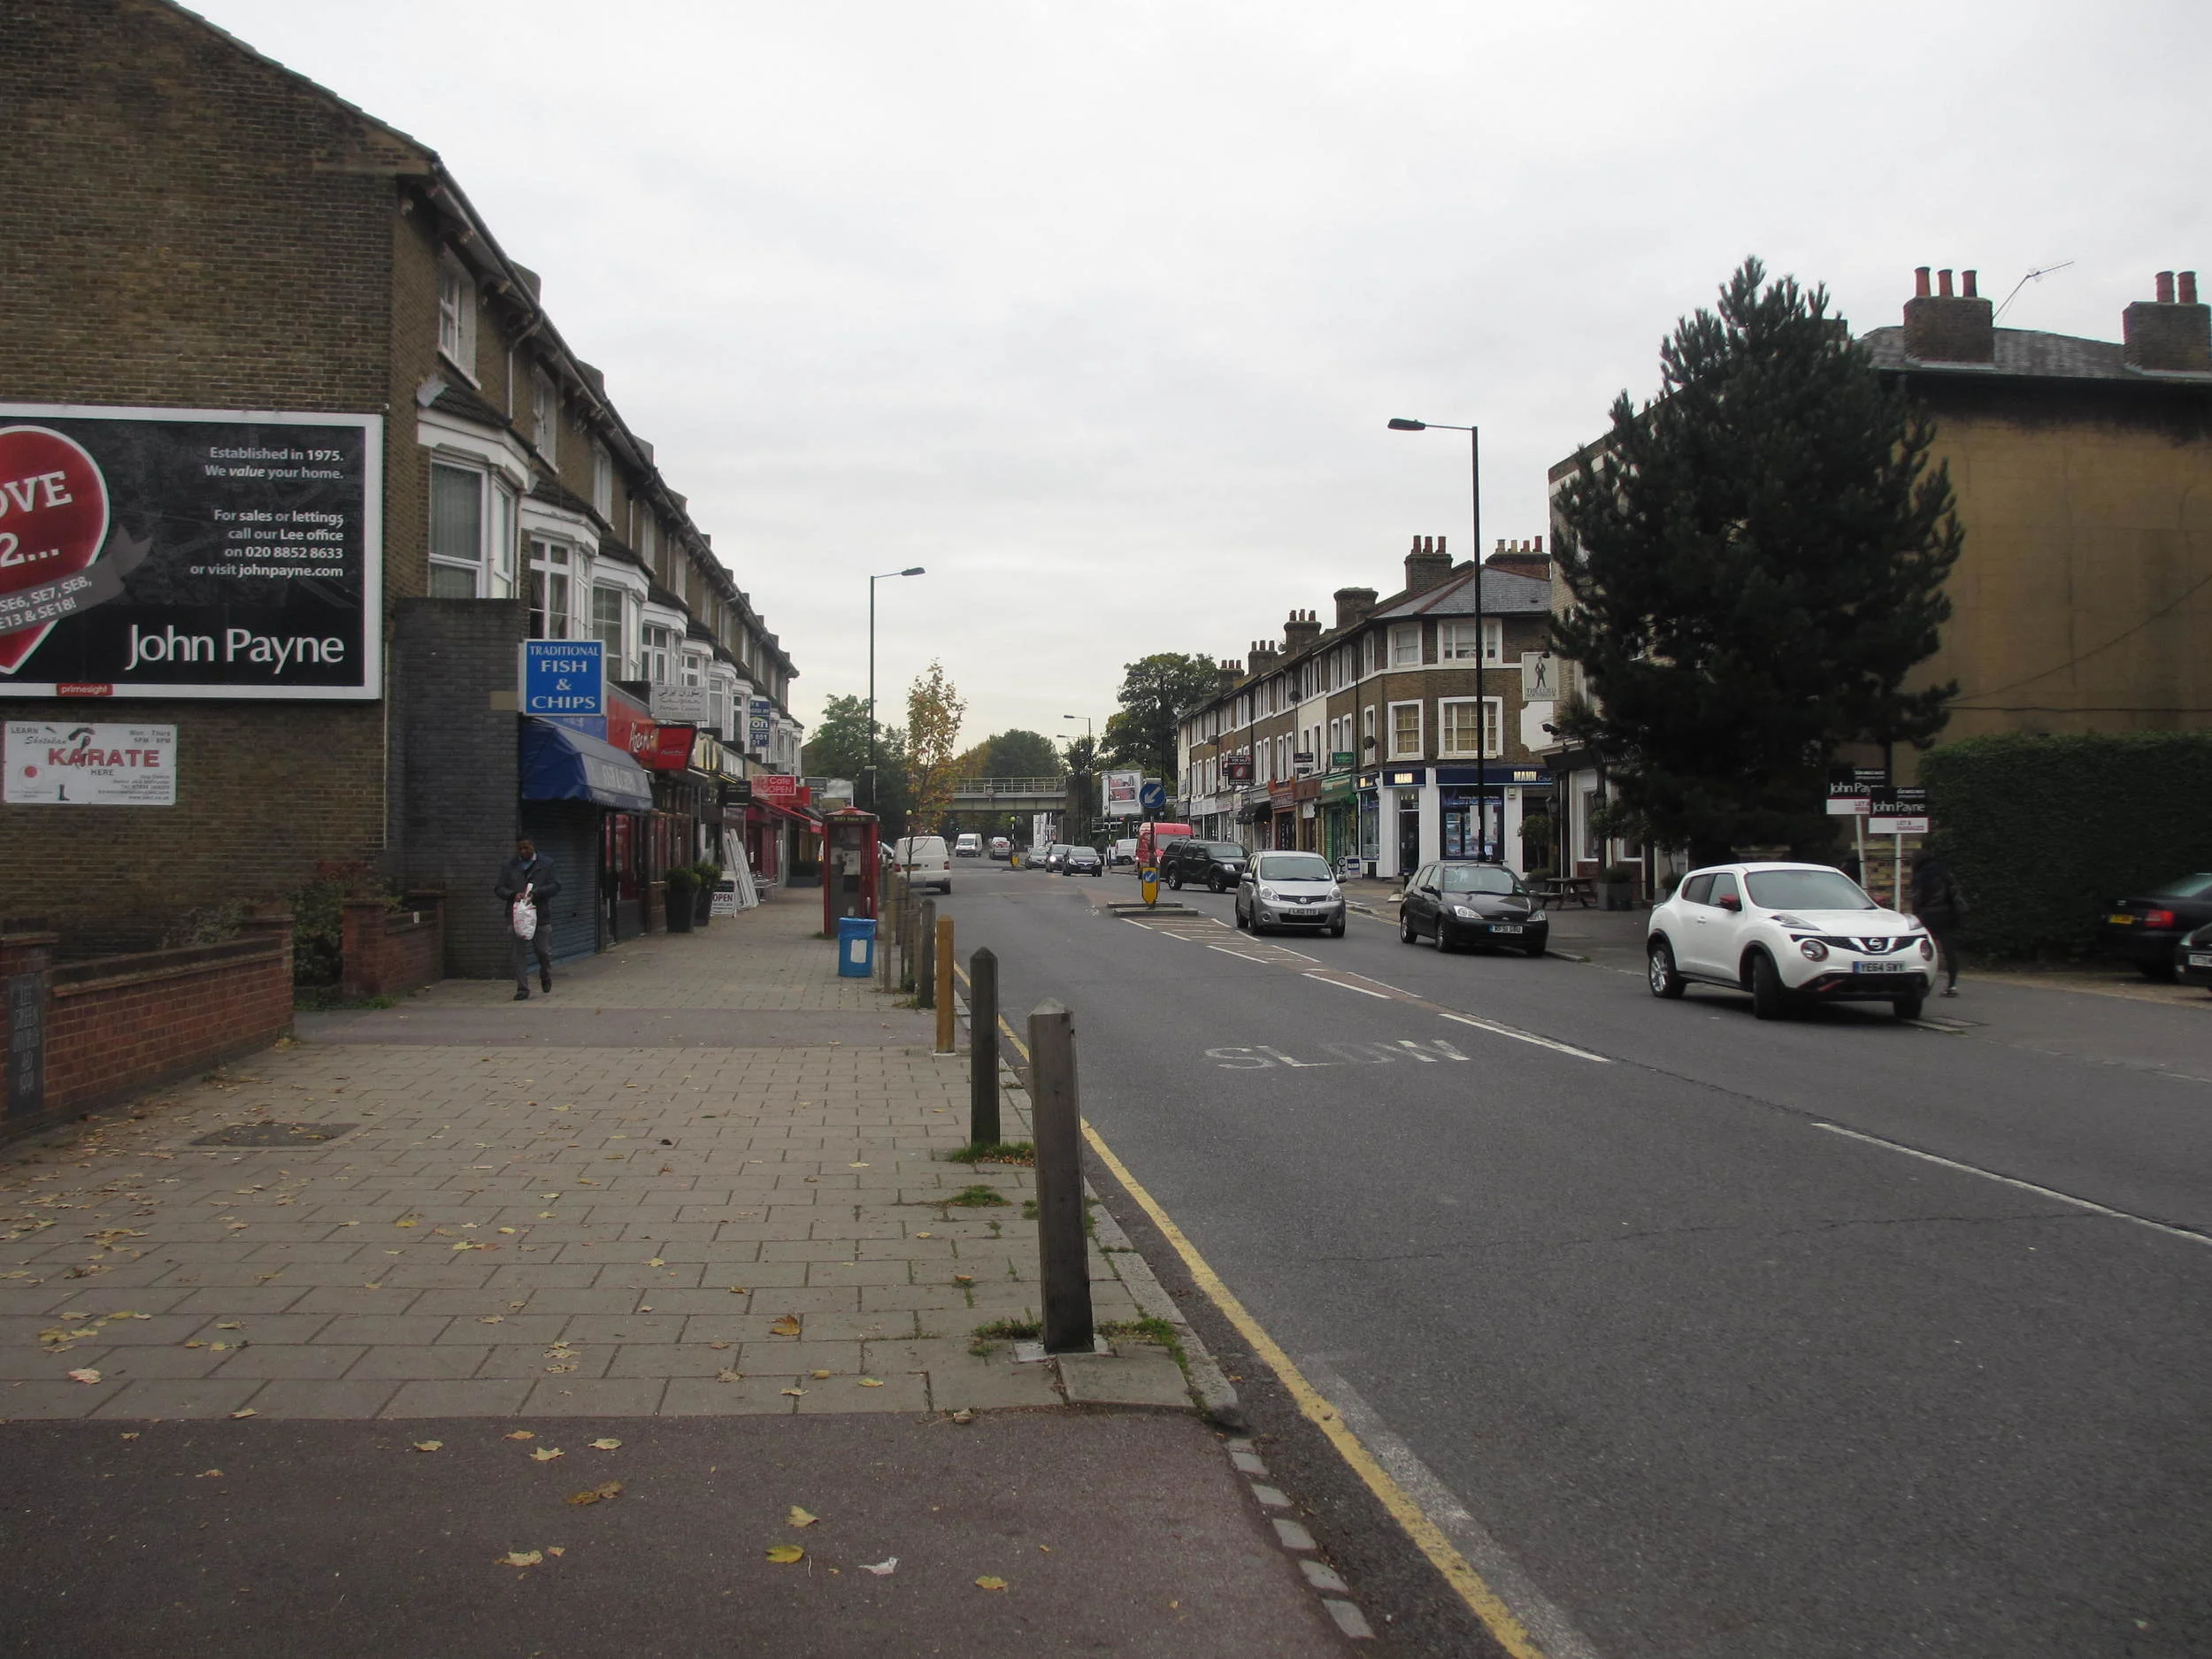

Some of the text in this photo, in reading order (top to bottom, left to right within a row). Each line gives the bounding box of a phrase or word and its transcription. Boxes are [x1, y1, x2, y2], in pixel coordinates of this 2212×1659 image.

[210, 447, 344, 461] Established in 1975.
[204, 465, 344, 480] We value your home.
[214, 509, 237, 520] For
[239, 510, 273, 522] sales
[275, 513, 290, 522] or
[228, 528, 344, 541] call our Lee office
[225, 547, 343, 559] on 020 8852 8633
[189, 564, 343, 578] or visit johnpayne.com
[31, 587, 62, 604] SE7,
[61, 576, 93, 595] SE8,
[25, 610, 36, 622] &
[38, 597, 77, 619] SE18!
[125, 625, 345, 674] John Payne
[530, 646, 599, 656] TRADITIONAL
[541, 660, 588, 672] FISH
[61, 685, 108, 695] primesight
[556, 678, 572, 690] &
[532, 695, 595, 709] CHIPS
[49, 748, 160, 768] KARATE
[1514, 771, 1537, 781] MANN
[1830, 782, 1853, 795] John
[1872, 800, 1925, 814] John Payne
[1203, 1039, 1471, 1069] SLOW
